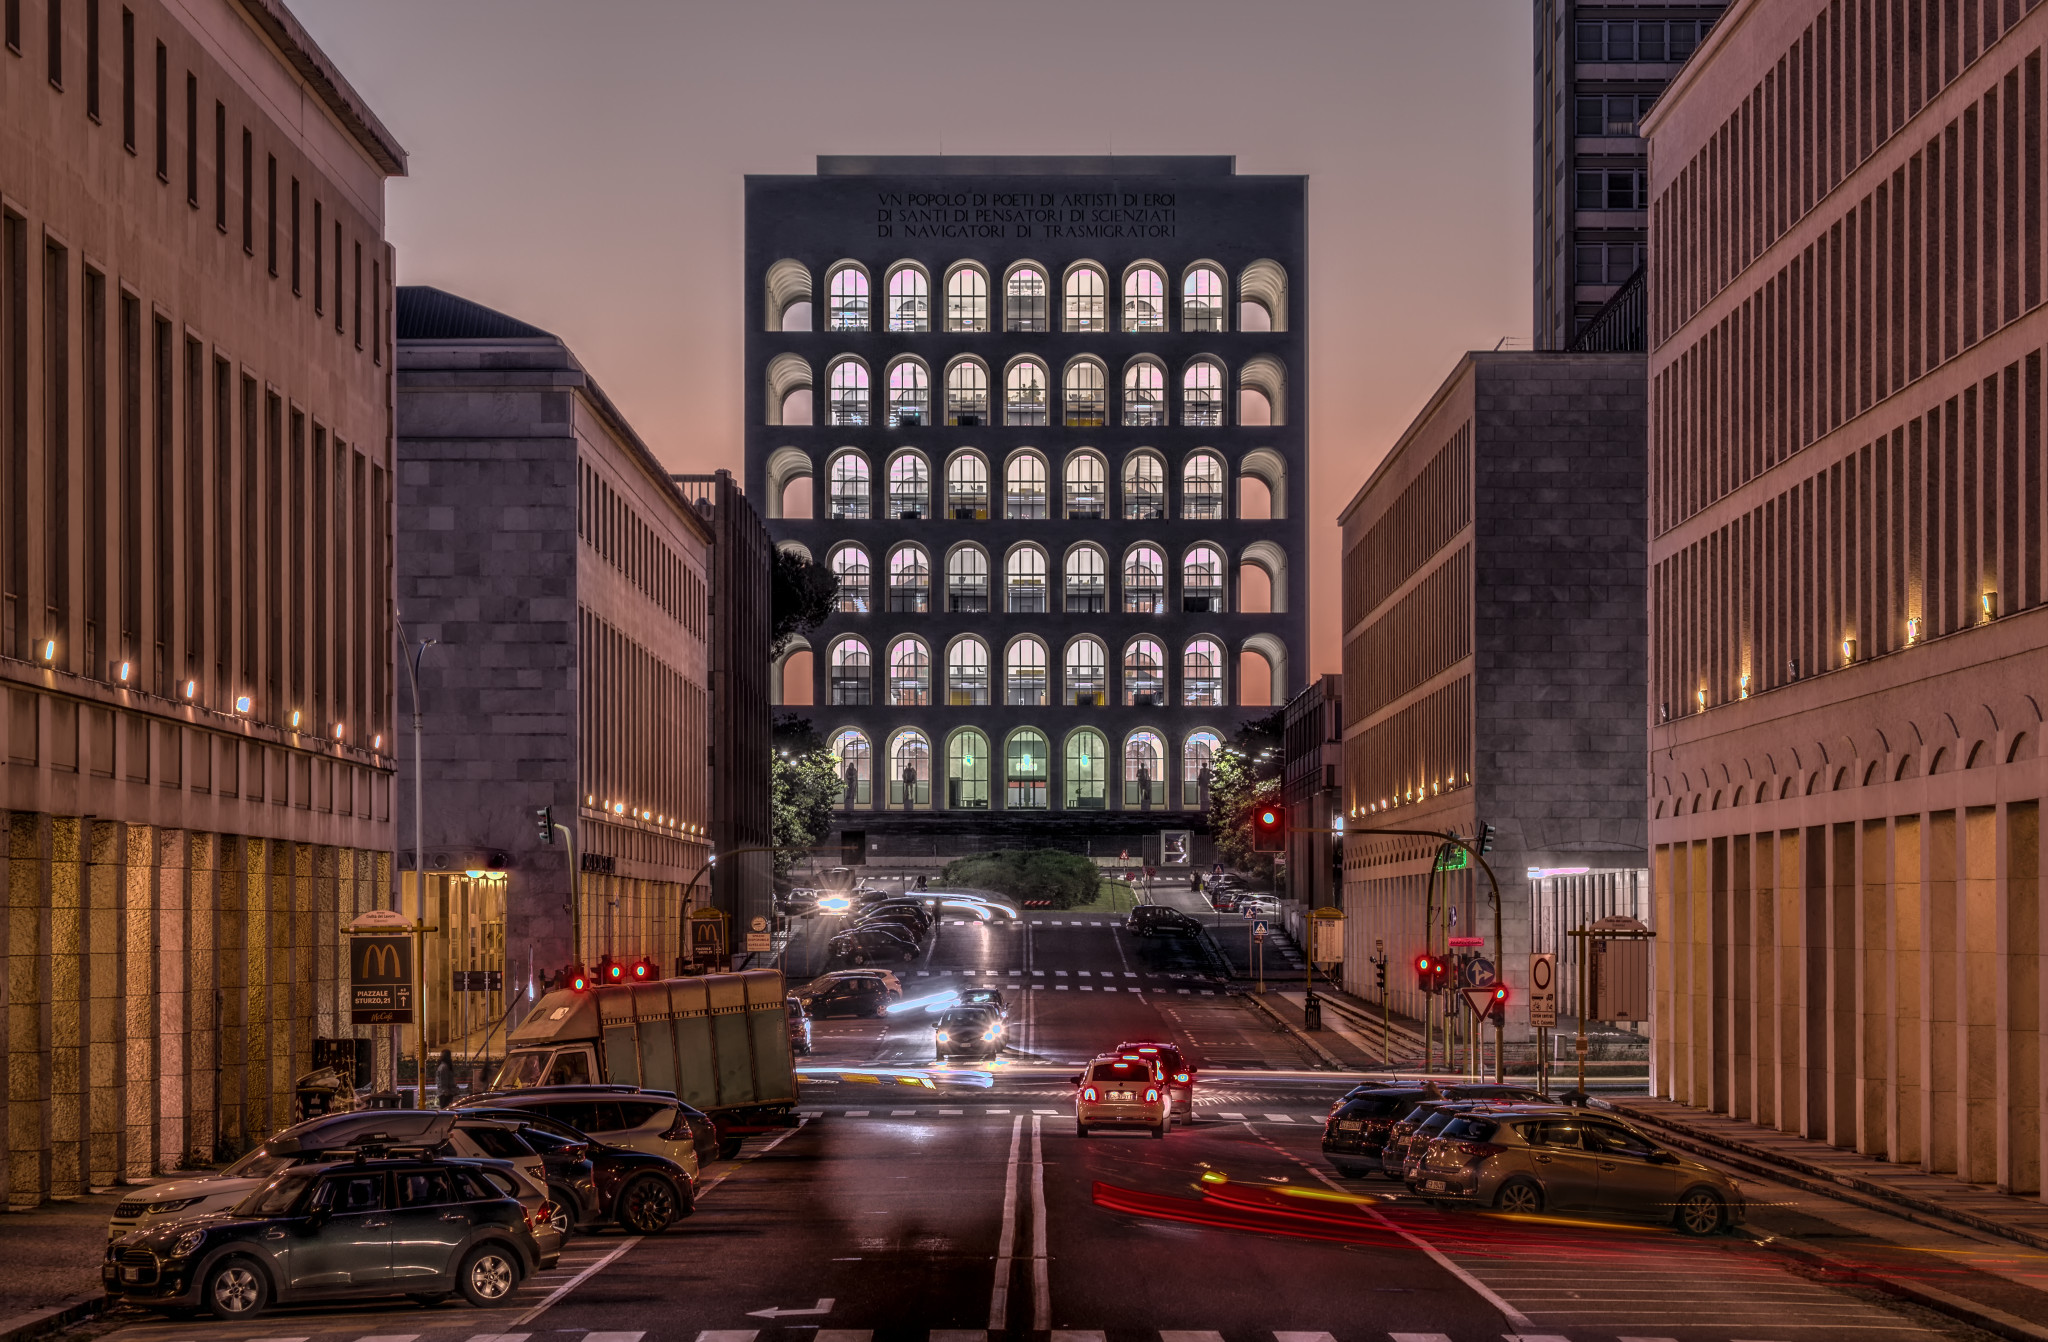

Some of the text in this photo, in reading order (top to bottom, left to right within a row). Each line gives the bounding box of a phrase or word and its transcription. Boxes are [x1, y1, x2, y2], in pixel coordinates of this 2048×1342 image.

[878, 193, 1175, 207] VN POPOLO DI POETI DI ARTISTI DI EROI
[877, 209, 1175, 222] DI SANTI DI PENSATORI DI SCIENZIATI
[877, 224, 1175, 238] DI NAVIGATORI DI TRASMIGRATORI
